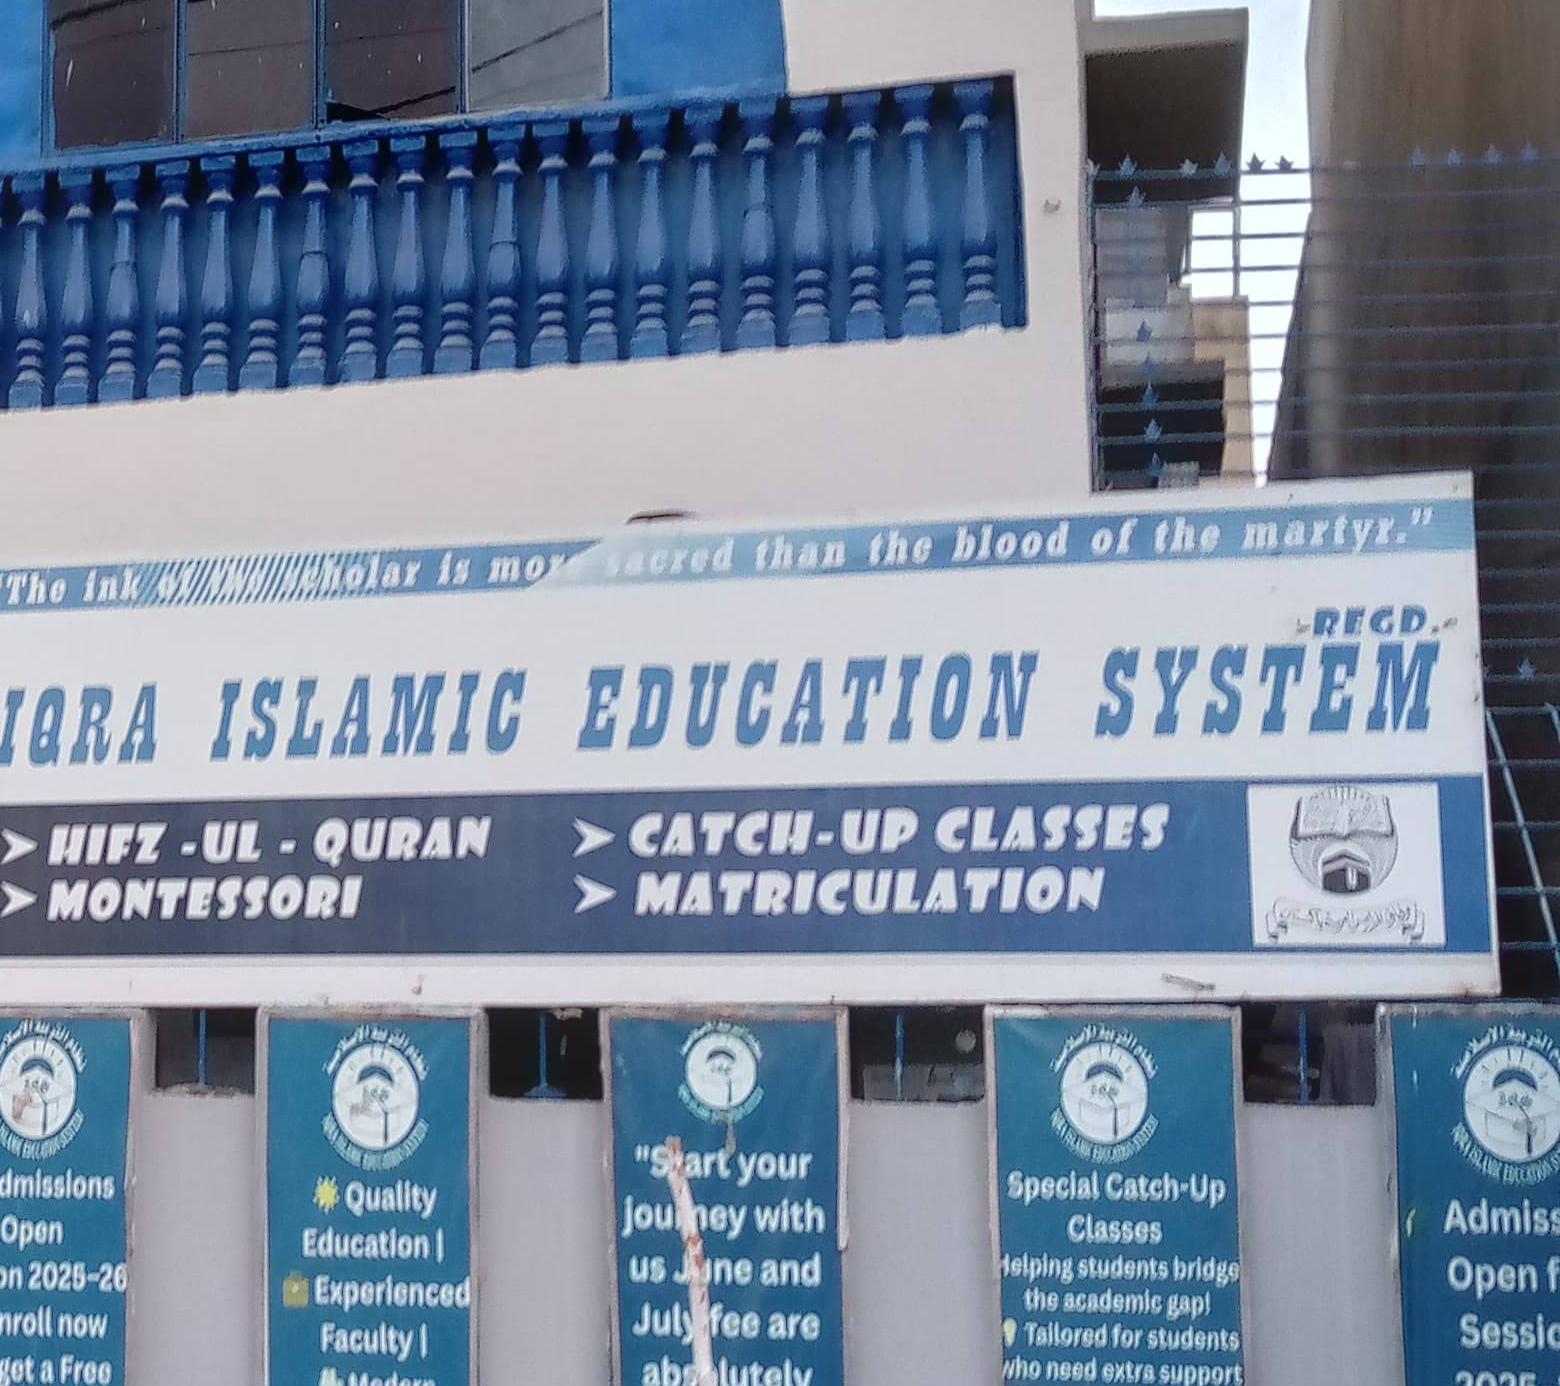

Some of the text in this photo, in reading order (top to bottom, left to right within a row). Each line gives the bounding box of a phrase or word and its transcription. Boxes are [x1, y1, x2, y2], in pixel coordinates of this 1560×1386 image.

[82, 567, 141, 603] ink
[437, 549, 471, 585] is
[754, 535, 847, 571] than
[869, 529, 933, 565] the
[952, 520, 1070, 562] blood
[1091, 517, 1138, 555] of
[1153, 516, 1221, 554] the
[209, 667, 529, 762] ISLAMIC
[577, 649, 1041, 751] EDUCATION
[1094, 639, 1440, 739] SYSTEM
[46, 814, 494, 870] HIFZ QURAN
[627, 804, 1171, 861] CATCH-UP CLASSES
[45, 874, 365, 922] MONTESSORI
[633, 866, 1108, 917] MATRICULATION
[736, 1152, 814, 1188] your
[1006, 1169, 1227, 1209] Special Catch-Up
[344, 1179, 438, 1220] Quality
[754, 1197, 826, 1235] with
[0, 1213, 64, 1251] Open
[302, 1225, 430, 1259] Education
[1066, 1213, 1164, 1245] Classes
[628, 1255, 667, 1284] us
[759, 1251, 822, 1288] and
[1076, 1253, 1169, 1284] students
[1173, 1255, 1240, 1289] bridge
[1447, 1254, 1539, 1302] Open
[314, 1272, 472, 1313] Experienced
[1023, 1287, 1059, 1313] the
[1062, 1288, 1162, 1314] academic
[57, 1313, 108, 1339] now
[321, 1321, 414, 1362] Faculty
[632, 1301, 821, 1346] July fee are
[1025, 1321, 1240, 1353] Tailored for students
[40, 1360, 54, 1385] a
[59, 1355, 112, 1386] Free
[1002, 1354, 1041, 1381] who
[1045, 1356, 1097, 1383] need
[1101, 1359, 1156, 1384] extra
